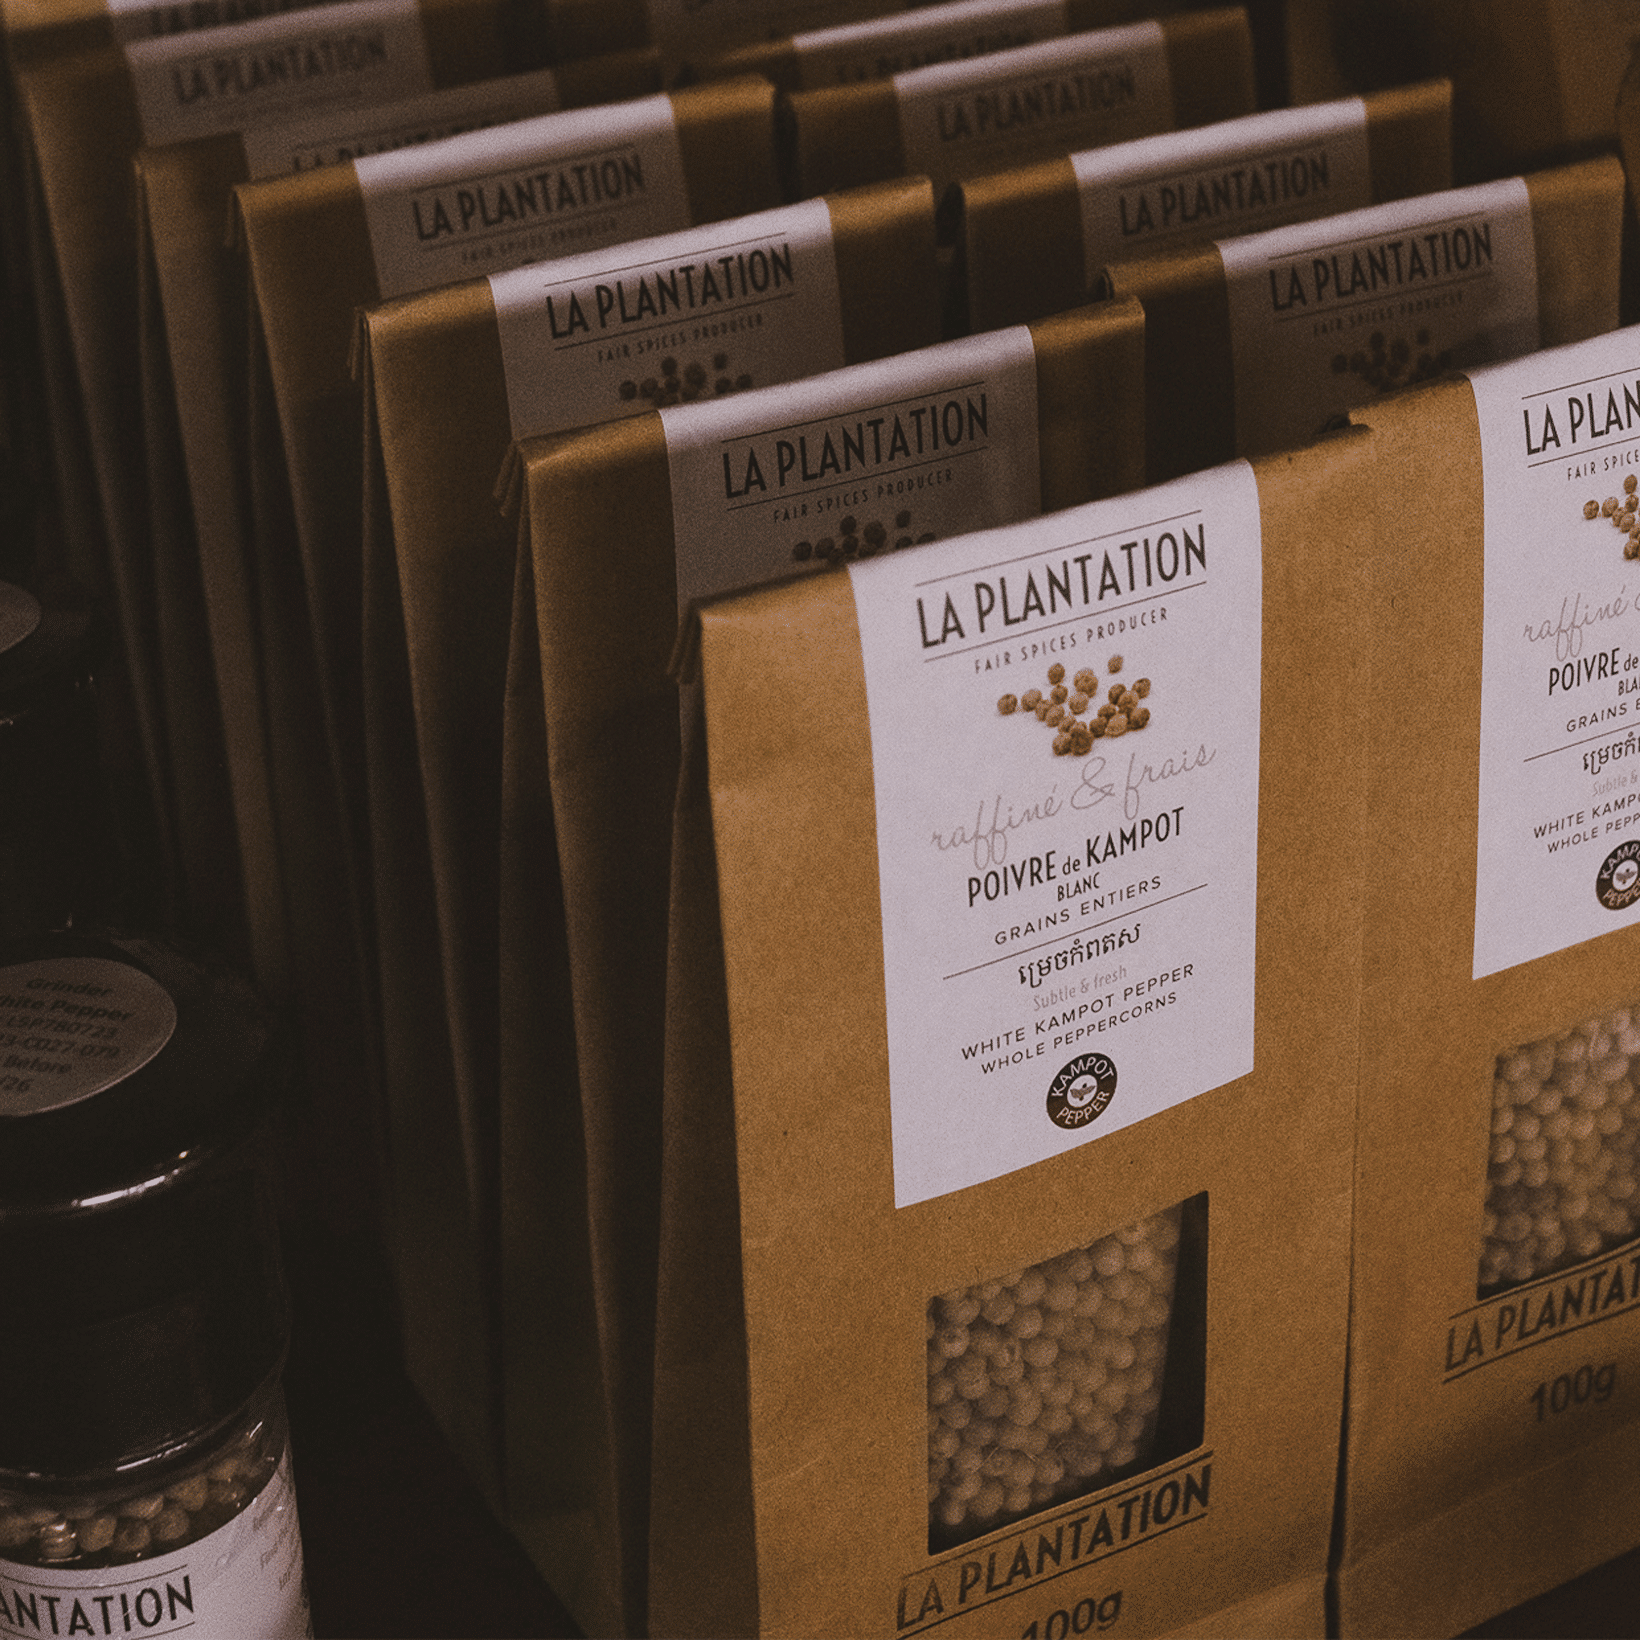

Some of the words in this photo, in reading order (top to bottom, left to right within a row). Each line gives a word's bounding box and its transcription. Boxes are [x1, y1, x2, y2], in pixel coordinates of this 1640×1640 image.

[412, 197, 455, 241] LA
[456, 152, 647, 232] PLANTATION
[1120, 191, 1155, 236] LA
[1160, 151, 1331, 226] PLANTATION
[546, 294, 591, 340] LA
[596, 245, 795, 329] PLANTATION
[1269, 265, 1308, 311] LA
[1312, 223, 1494, 302] PLANTATION
[597, 344, 631, 364] FAIR
[637, 331, 687, 355] SPICES
[693, 312, 764, 340] PRODUCER
[722, 446, 767, 499] LA
[775, 393, 988, 487] PLANTATION
[1523, 403, 1561, 456] LA
[772, 504, 808, 523] FAIR
[817, 489, 869, 514] SPICES
[877, 469, 953, 499] PRODUCER
[1567, 461, 1597, 482] FAIR
[916, 591, 966, 649] LA
[974, 523, 1207, 634] PLANTATION
[974, 651, 1012, 674] FAIR
[1021, 632, 1077, 661] SPICES
[1086, 607, 1168, 643] PRODUCER
[1549, 647, 1620, 697] POIVRE
[1623, 653, 1640, 672] de
[1617, 677, 1640, 696] BLA
[1566, 702, 1628, 733] GRAINS
[930, 784, 1063, 870] raffiné
[1070, 756, 1117, 810] &
[1123, 744, 1217, 821] frais
[1533, 811, 1585, 839] WHITE
[1592, 793, 1640, 819] KAMP
[968, 850, 1057, 907] POIVRE
[1061, 856, 1081, 876] de
[1086, 806, 1185, 868] KAMPOT
[1547, 826, 1599, 853] WHOLE
[994, 909, 1071, 945] GRAINS
[1080, 875, 1162, 916] ENTIERS
[1056, 872, 1101, 902] BLANC
[0, 995, 45, 1011] hite
[50, 1000, 136, 1024] Pepper
[26, 978, 115, 998] Grinder
[961, 1027, 1026, 1061] WHITE
[1035, 993, 1116, 1035] KAMPOT
[1123, 963, 1195, 1002] PEPPER
[1033, 985, 1077, 1012] Subtle
[1079, 977, 1091, 995] &
[1094, 965, 1128, 990] fresh
[981, 1043, 1046, 1075] WHOLE
[1053, 991, 1178, 1049] PEPPERCORNS
[1051, 1056, 1115, 1097] KAMPOT
[1056, 1090, 1111, 1125] PEPPER
[1445, 1317, 1484, 1372] LA
[1531, 1363, 1618, 1423] 100g
[897, 1578, 945, 1632] LA
[958, 1464, 1213, 1605] PLANTATION
